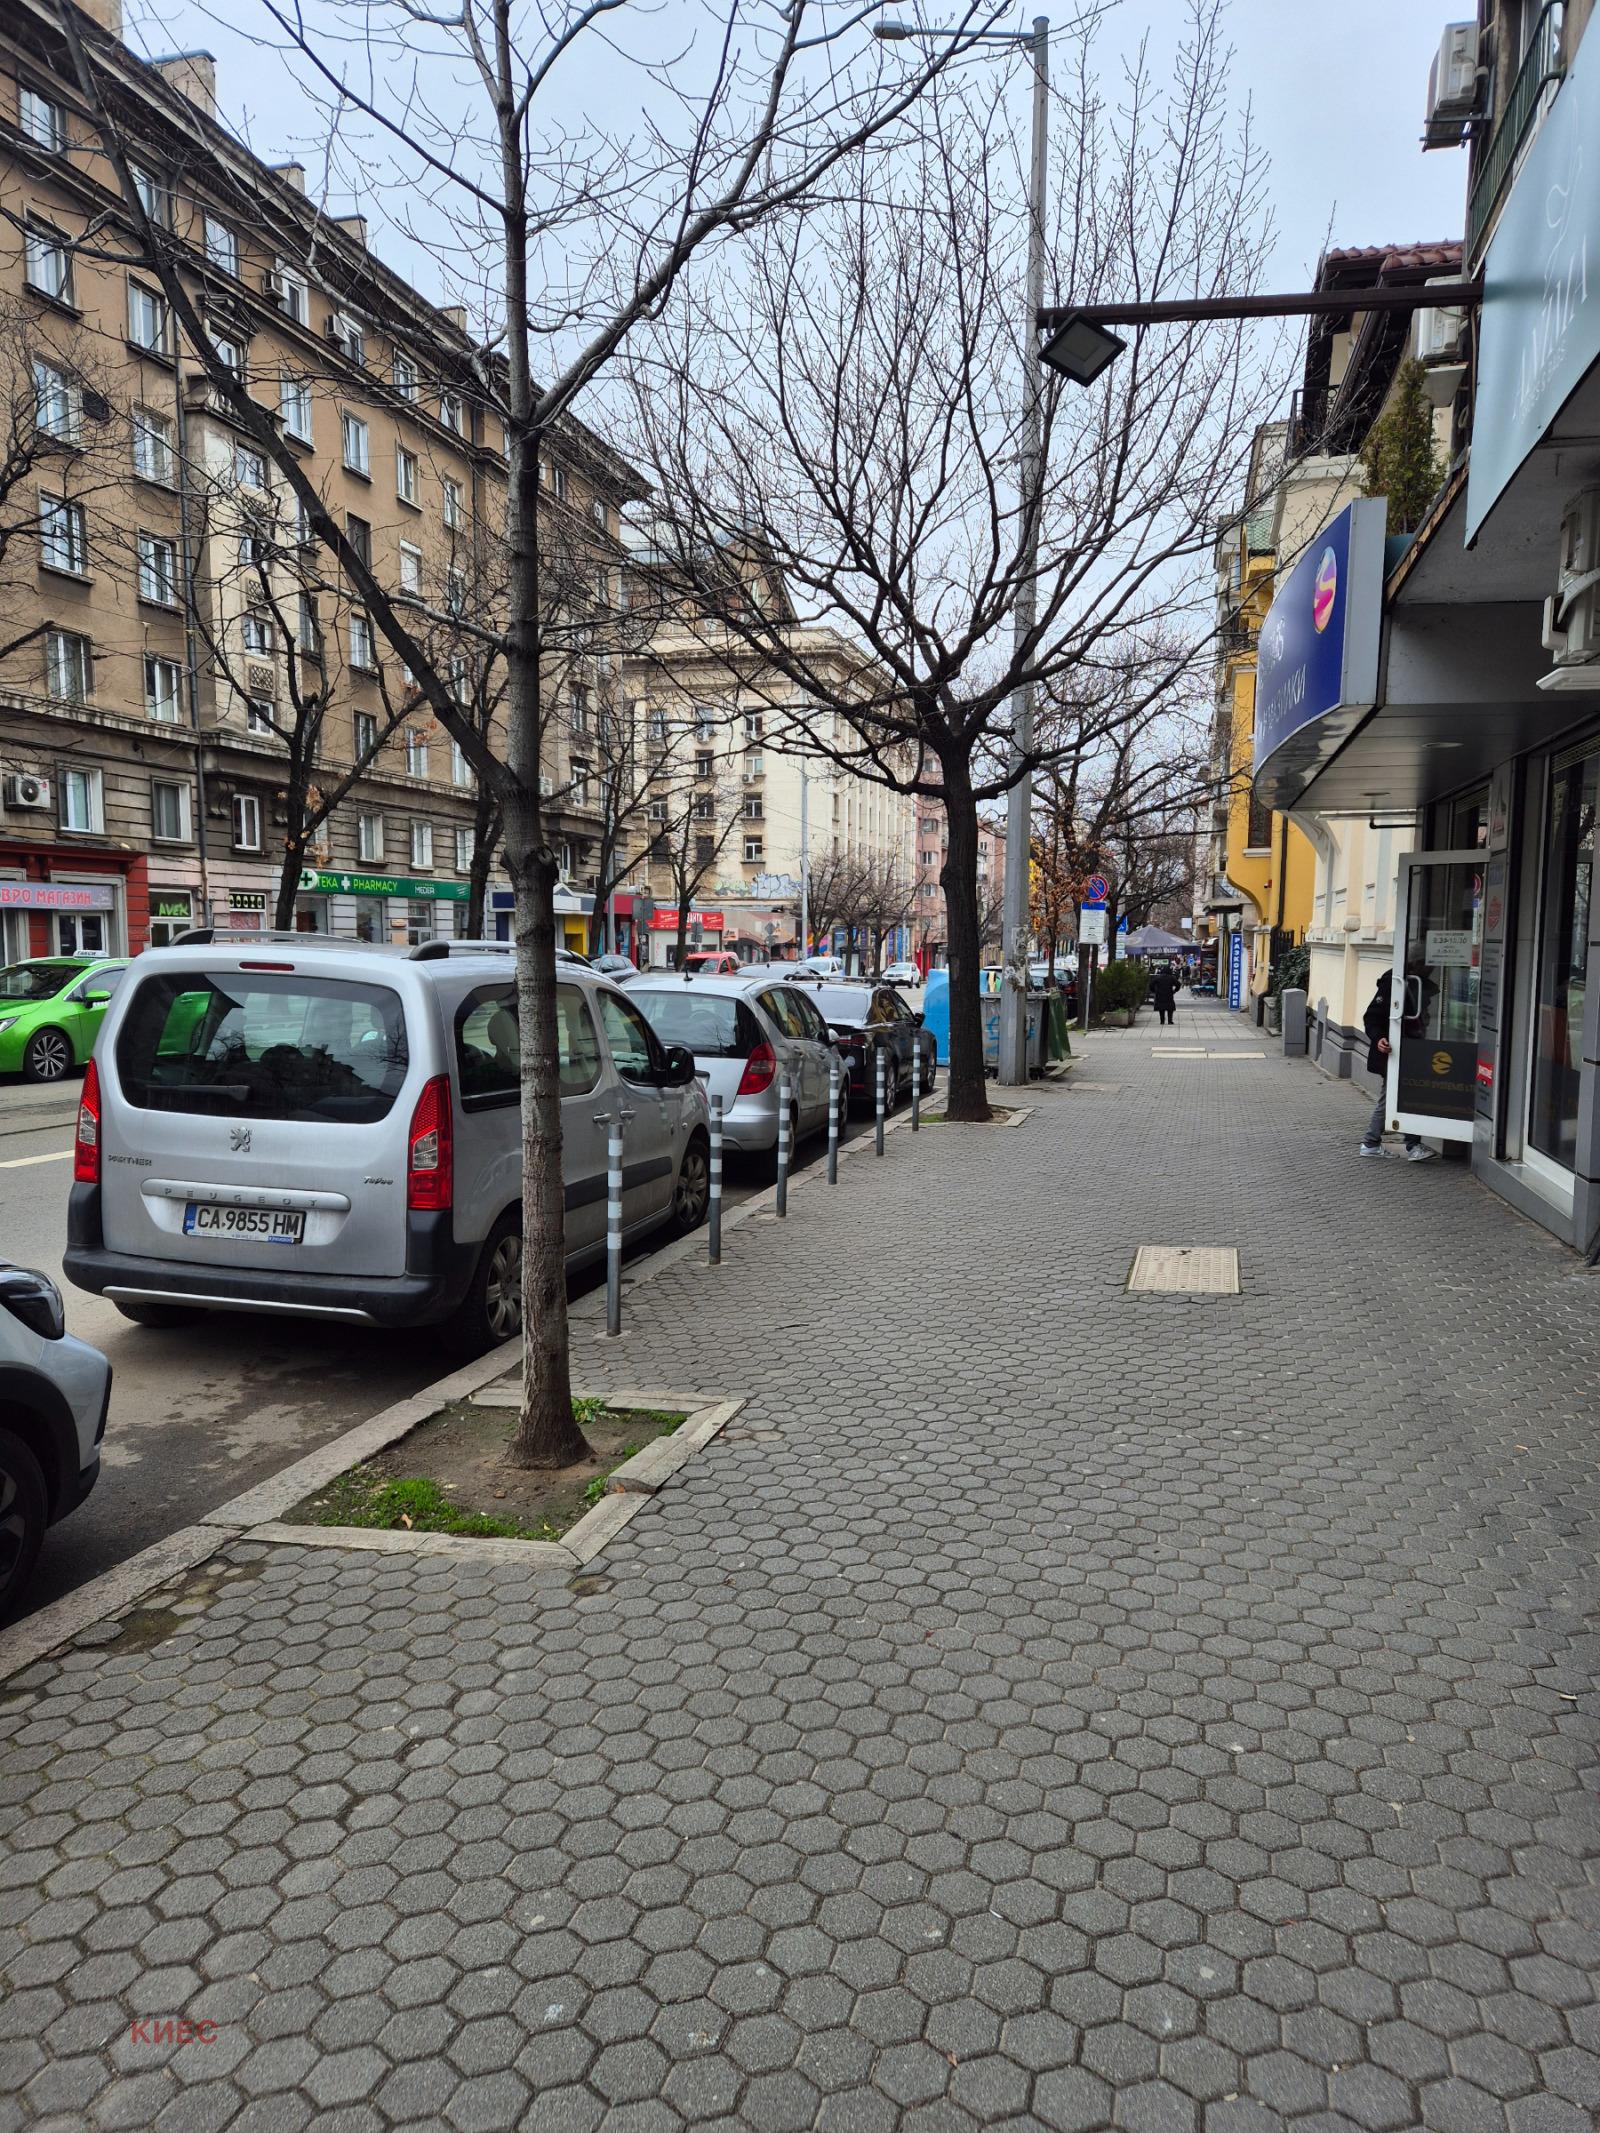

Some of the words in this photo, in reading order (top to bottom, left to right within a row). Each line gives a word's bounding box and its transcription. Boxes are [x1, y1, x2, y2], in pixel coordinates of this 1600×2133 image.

[317, 875, 339, 889] ТЕКА
[353, 878, 398, 892] PHARMACY
[0, 888, 31, 904] ВРО
[36, 890, 92, 906] МАГАЗИН
[1232, 937, 1241, 1006] РАЗКОДИРАНЕ
[1402, 1077, 1431, 1088] COLOR
[1431, 1080, 1464, 1092] SYSTEMS
[108, 1155, 152, 1166] PARTNER
[165, 1188, 317, 1206] PEUGEOT
[225, 1211, 269, 1233] 9855
[273, 1214, 300, 1236] HM
